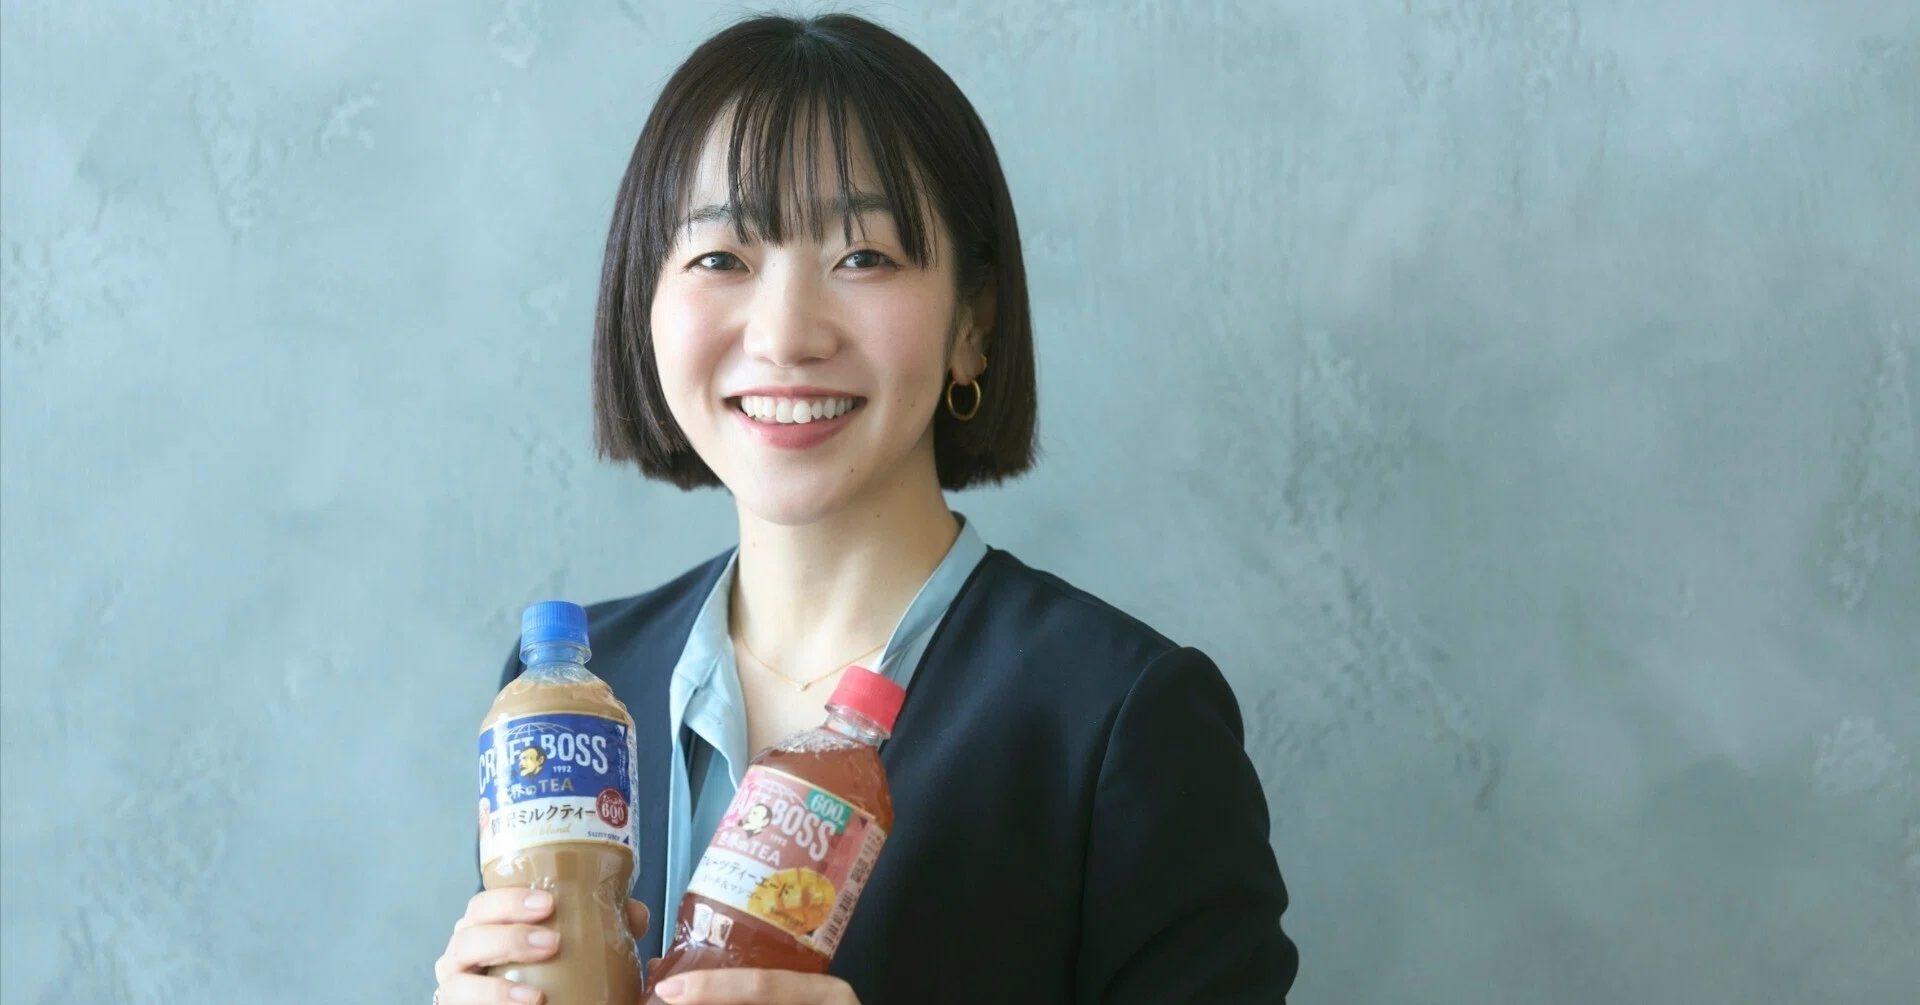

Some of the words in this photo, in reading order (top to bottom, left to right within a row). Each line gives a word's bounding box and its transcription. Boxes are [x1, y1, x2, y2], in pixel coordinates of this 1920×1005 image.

[541, 733, 609, 775] BOSS
[552, 765, 573, 774] 1992
[498, 778, 575, 804] 界のTEA
[491, 803, 597, 837] ミルクティー
[601, 802, 625, 821] 600
[811, 794, 843, 821] 600
[771, 798, 837, 862] BOSS
